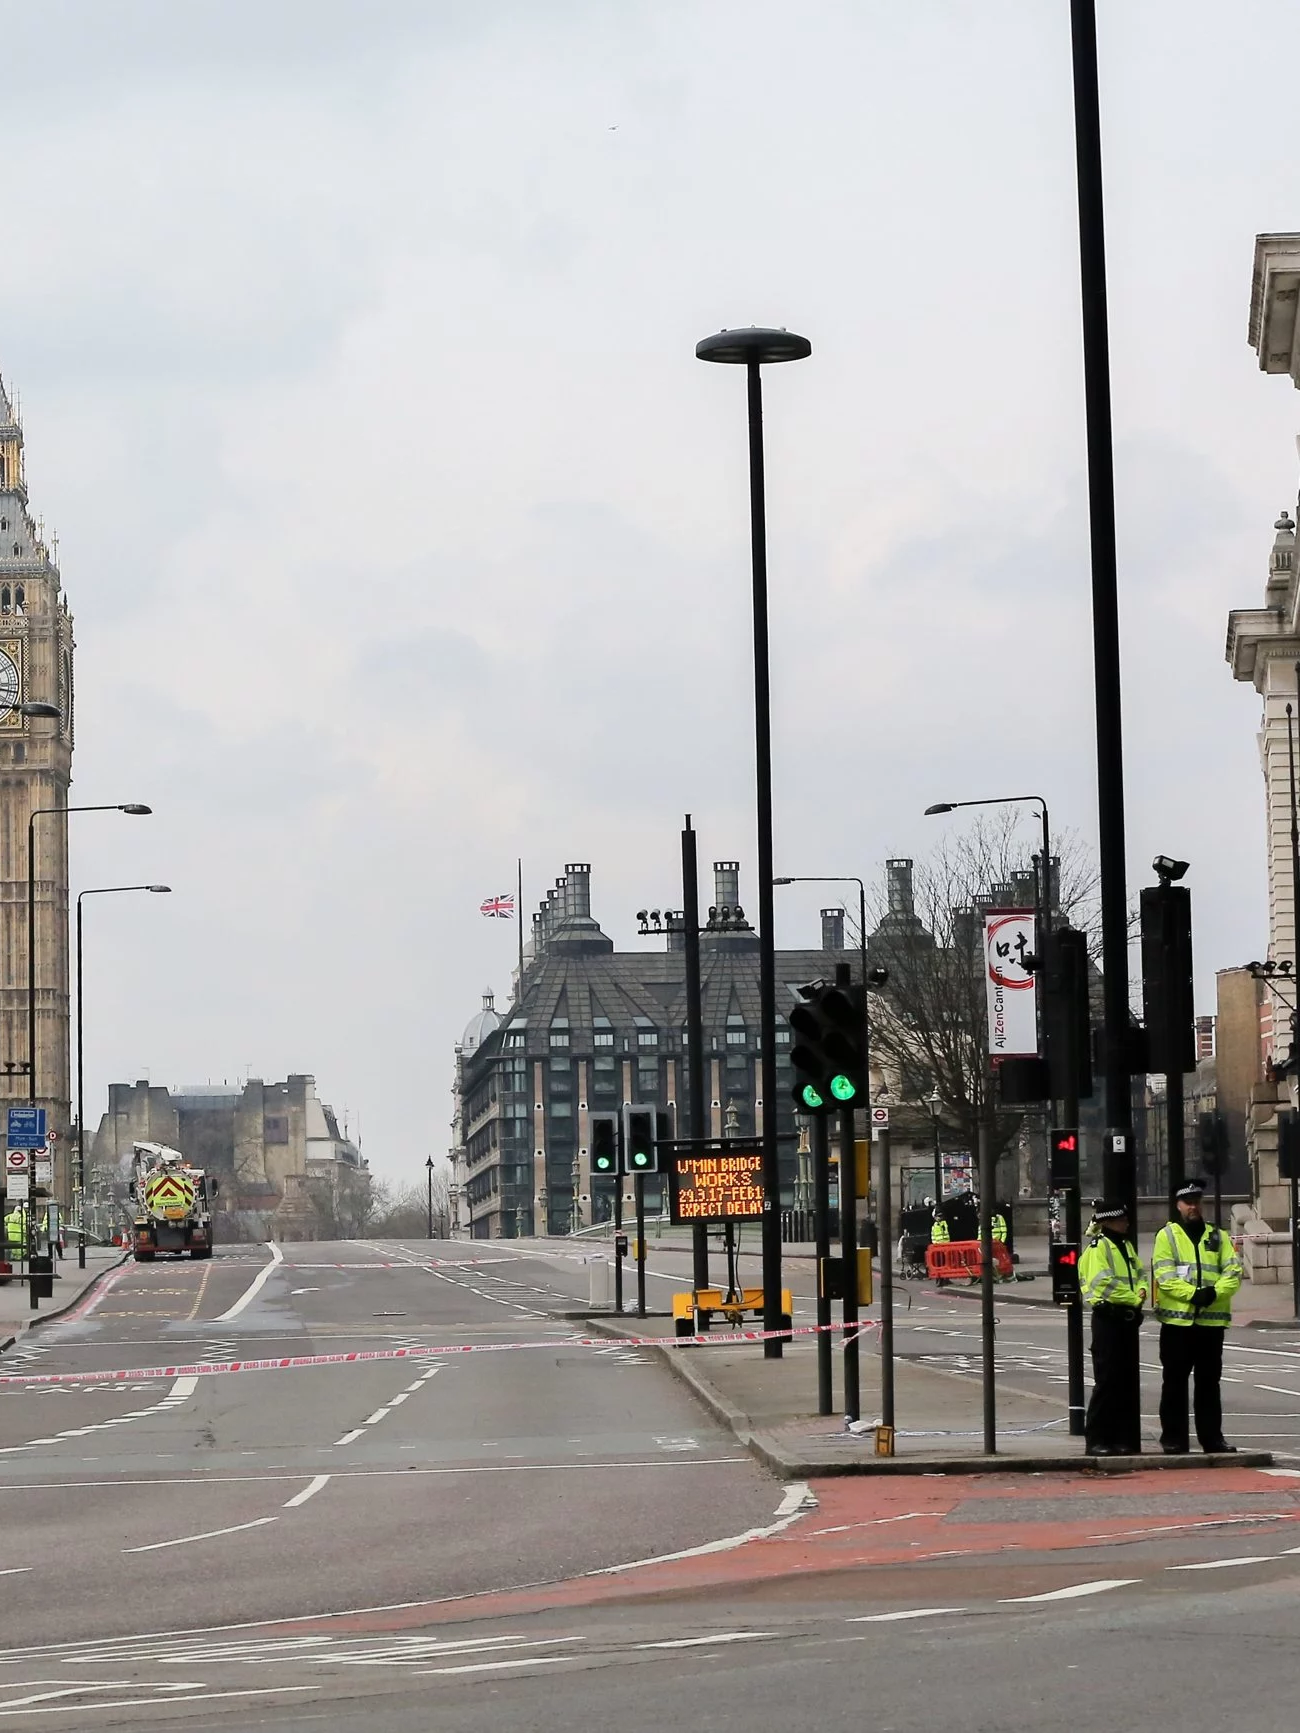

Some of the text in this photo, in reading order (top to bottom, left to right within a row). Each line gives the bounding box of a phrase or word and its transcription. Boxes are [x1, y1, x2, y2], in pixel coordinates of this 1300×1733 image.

[721, 1157, 761, 1171] BRIDGE
[695, 1172, 752, 1187] WORKS
[680, 1202, 723, 1217] EXPECT
